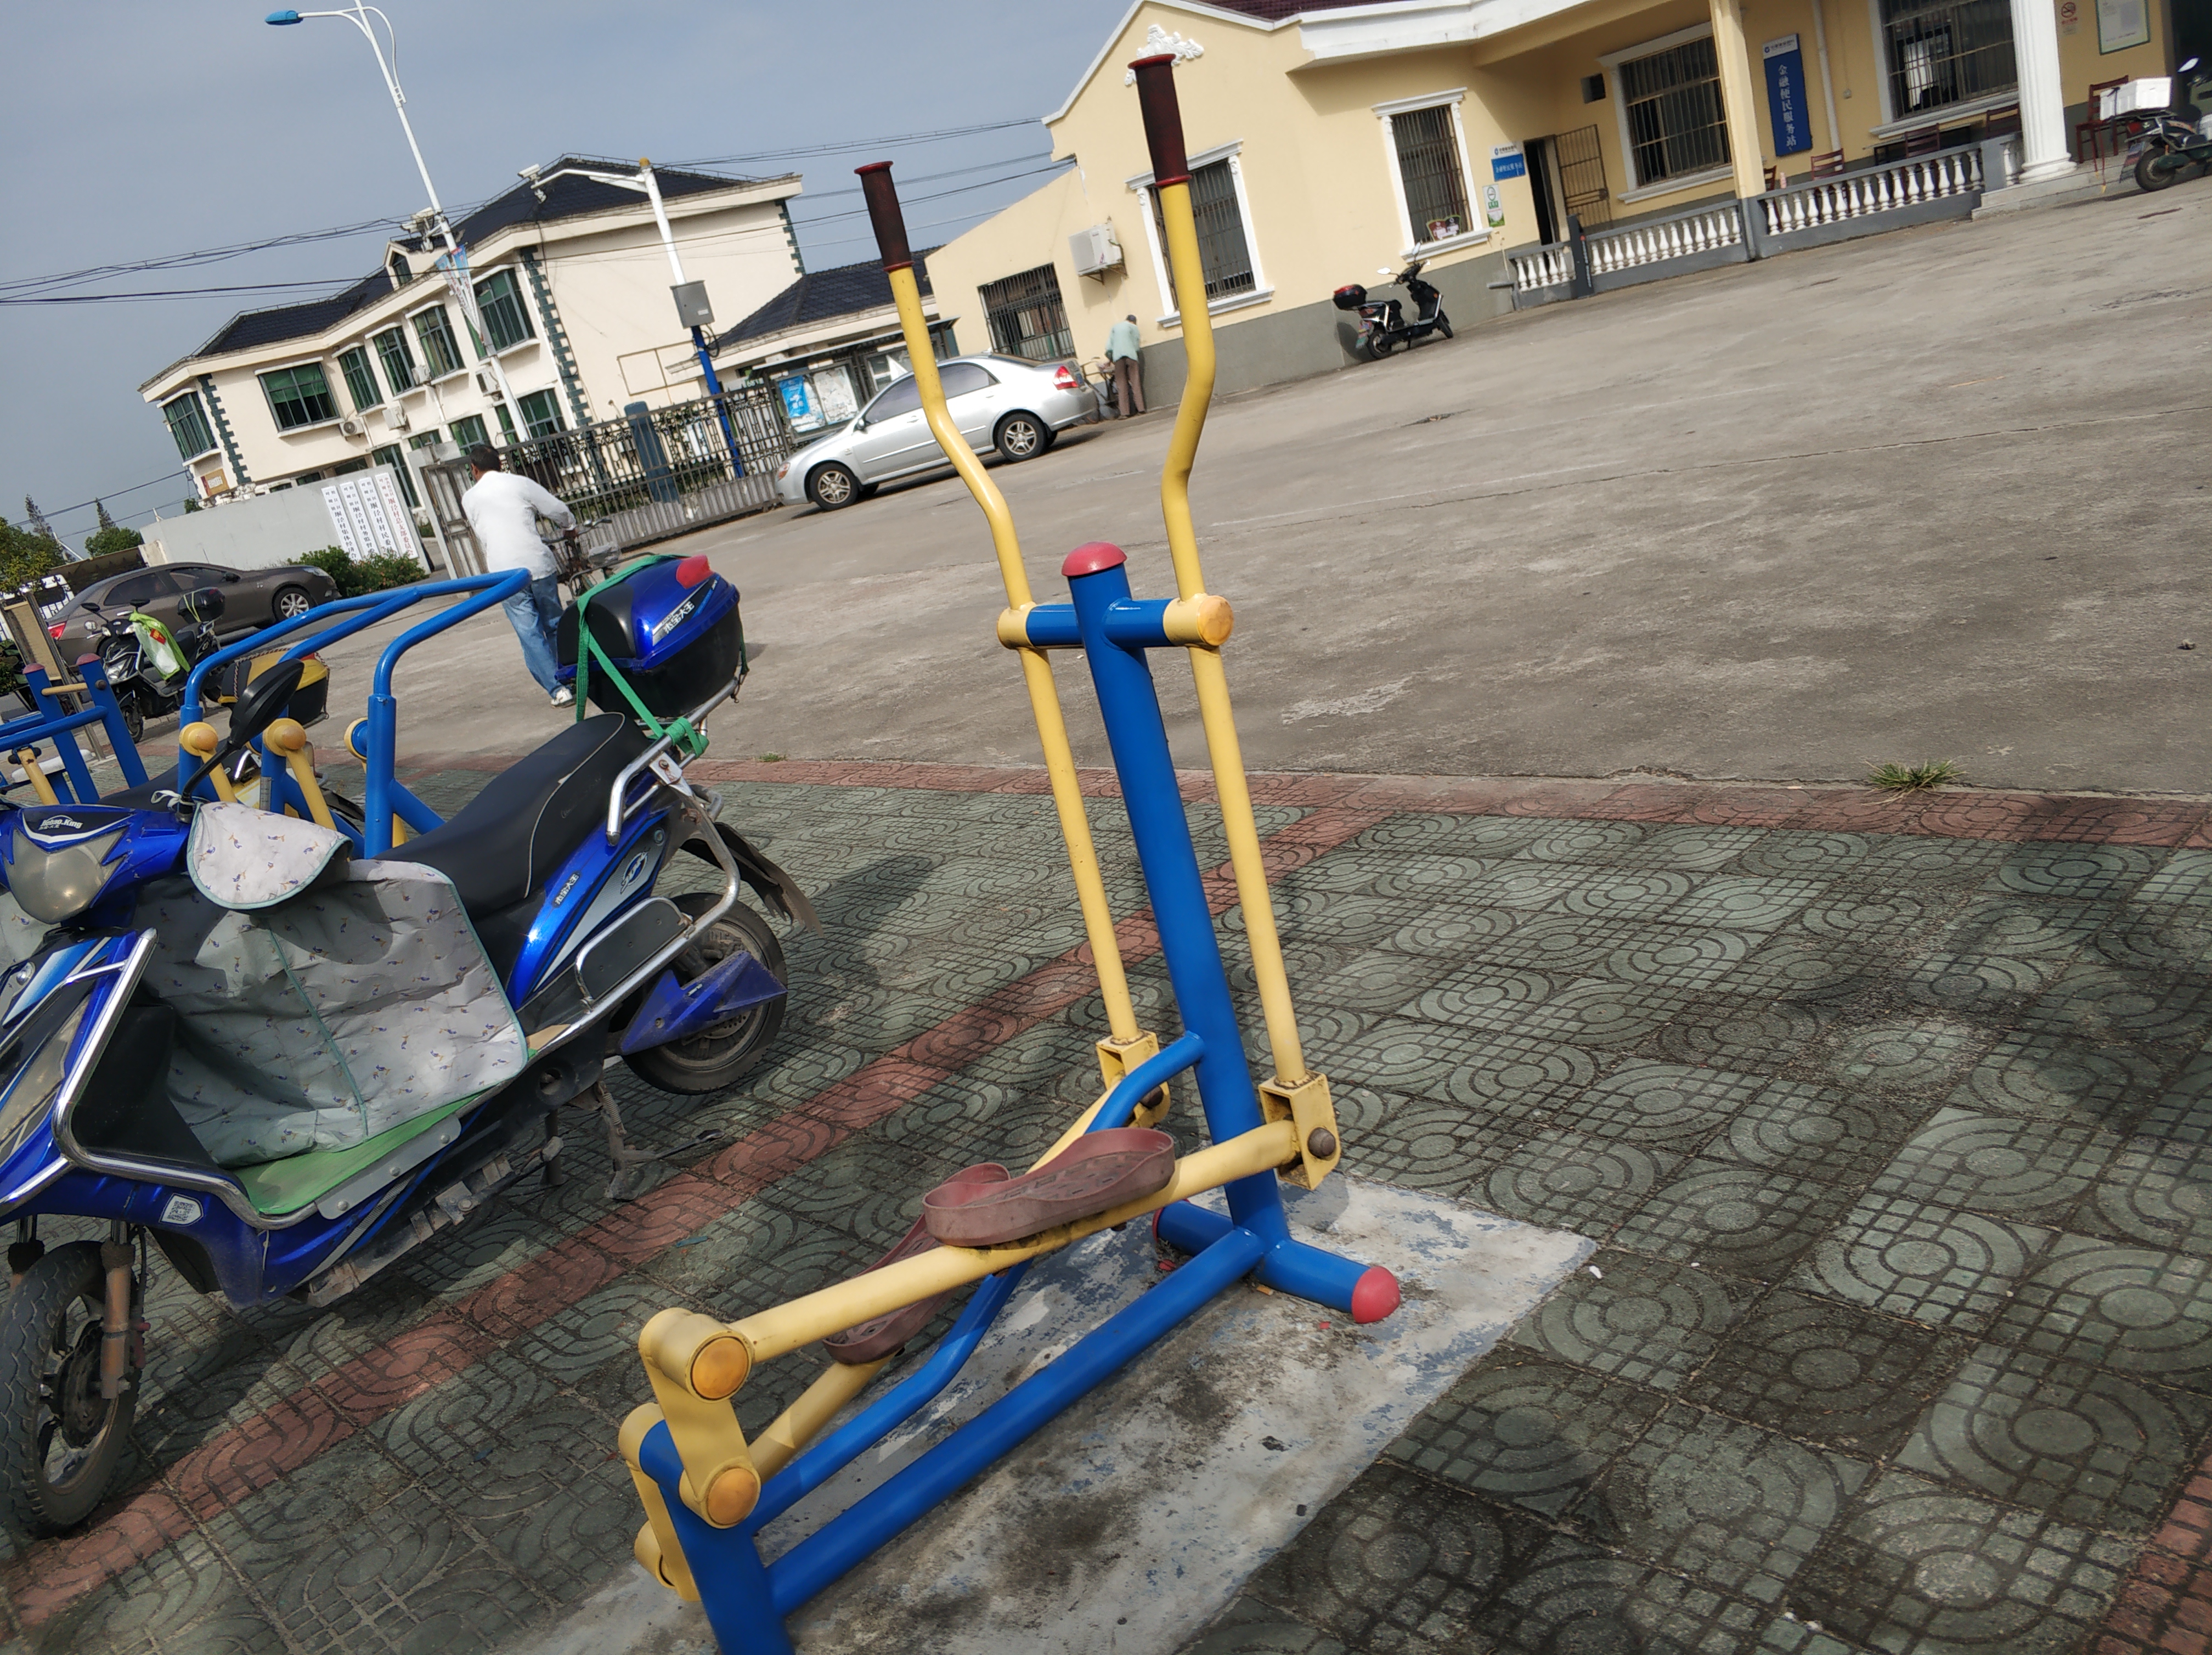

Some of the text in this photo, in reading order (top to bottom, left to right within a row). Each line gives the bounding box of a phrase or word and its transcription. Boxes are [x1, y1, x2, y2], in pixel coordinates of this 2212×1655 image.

[1778, 64, 1797, 147] 金融便民服务站
[664, 601, 695, 634] 杰宝大王
